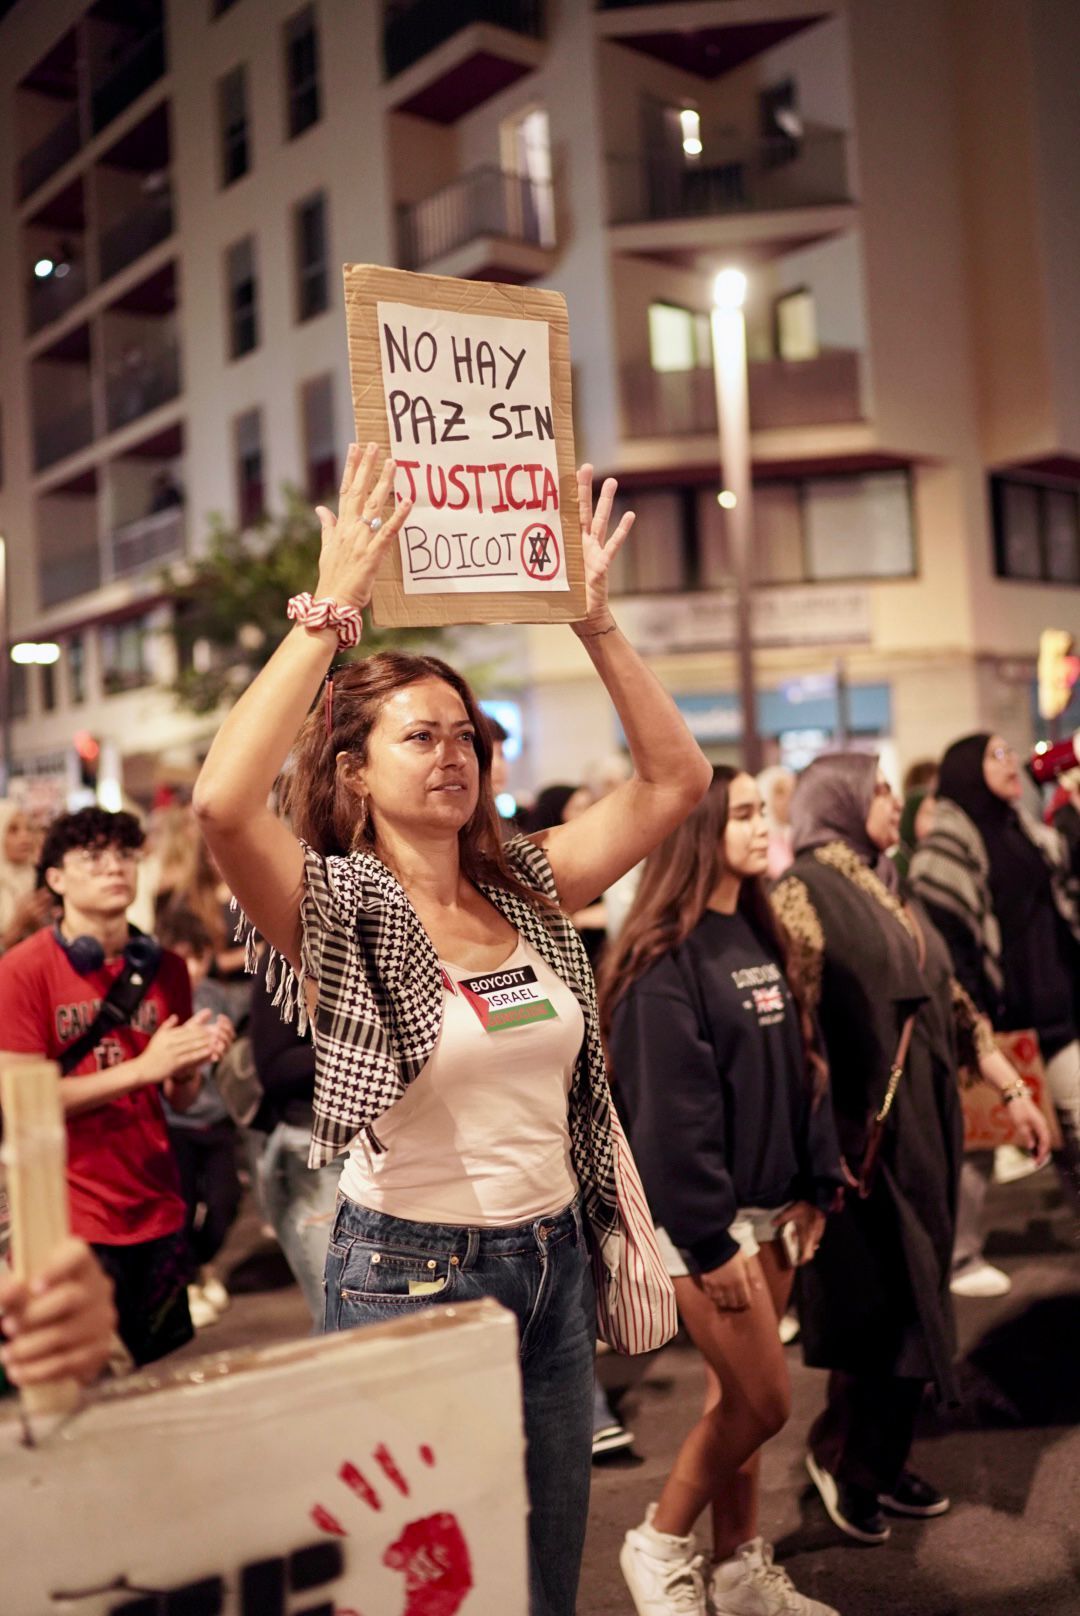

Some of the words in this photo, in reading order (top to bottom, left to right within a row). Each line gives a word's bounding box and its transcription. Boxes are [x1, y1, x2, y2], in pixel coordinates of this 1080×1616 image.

[383, 323, 438, 374] NO
[451, 335, 526, 390] HAY
[389, 389, 470, 445] PAZ
[489, 402, 555, 440] SIN
[395, 460, 558, 513] JUSTICIA
[404, 525, 517, 574] BOICOT
[470, 970, 525, 993] BOYCOTT
[487, 988, 538, 1008] ISRAEL
